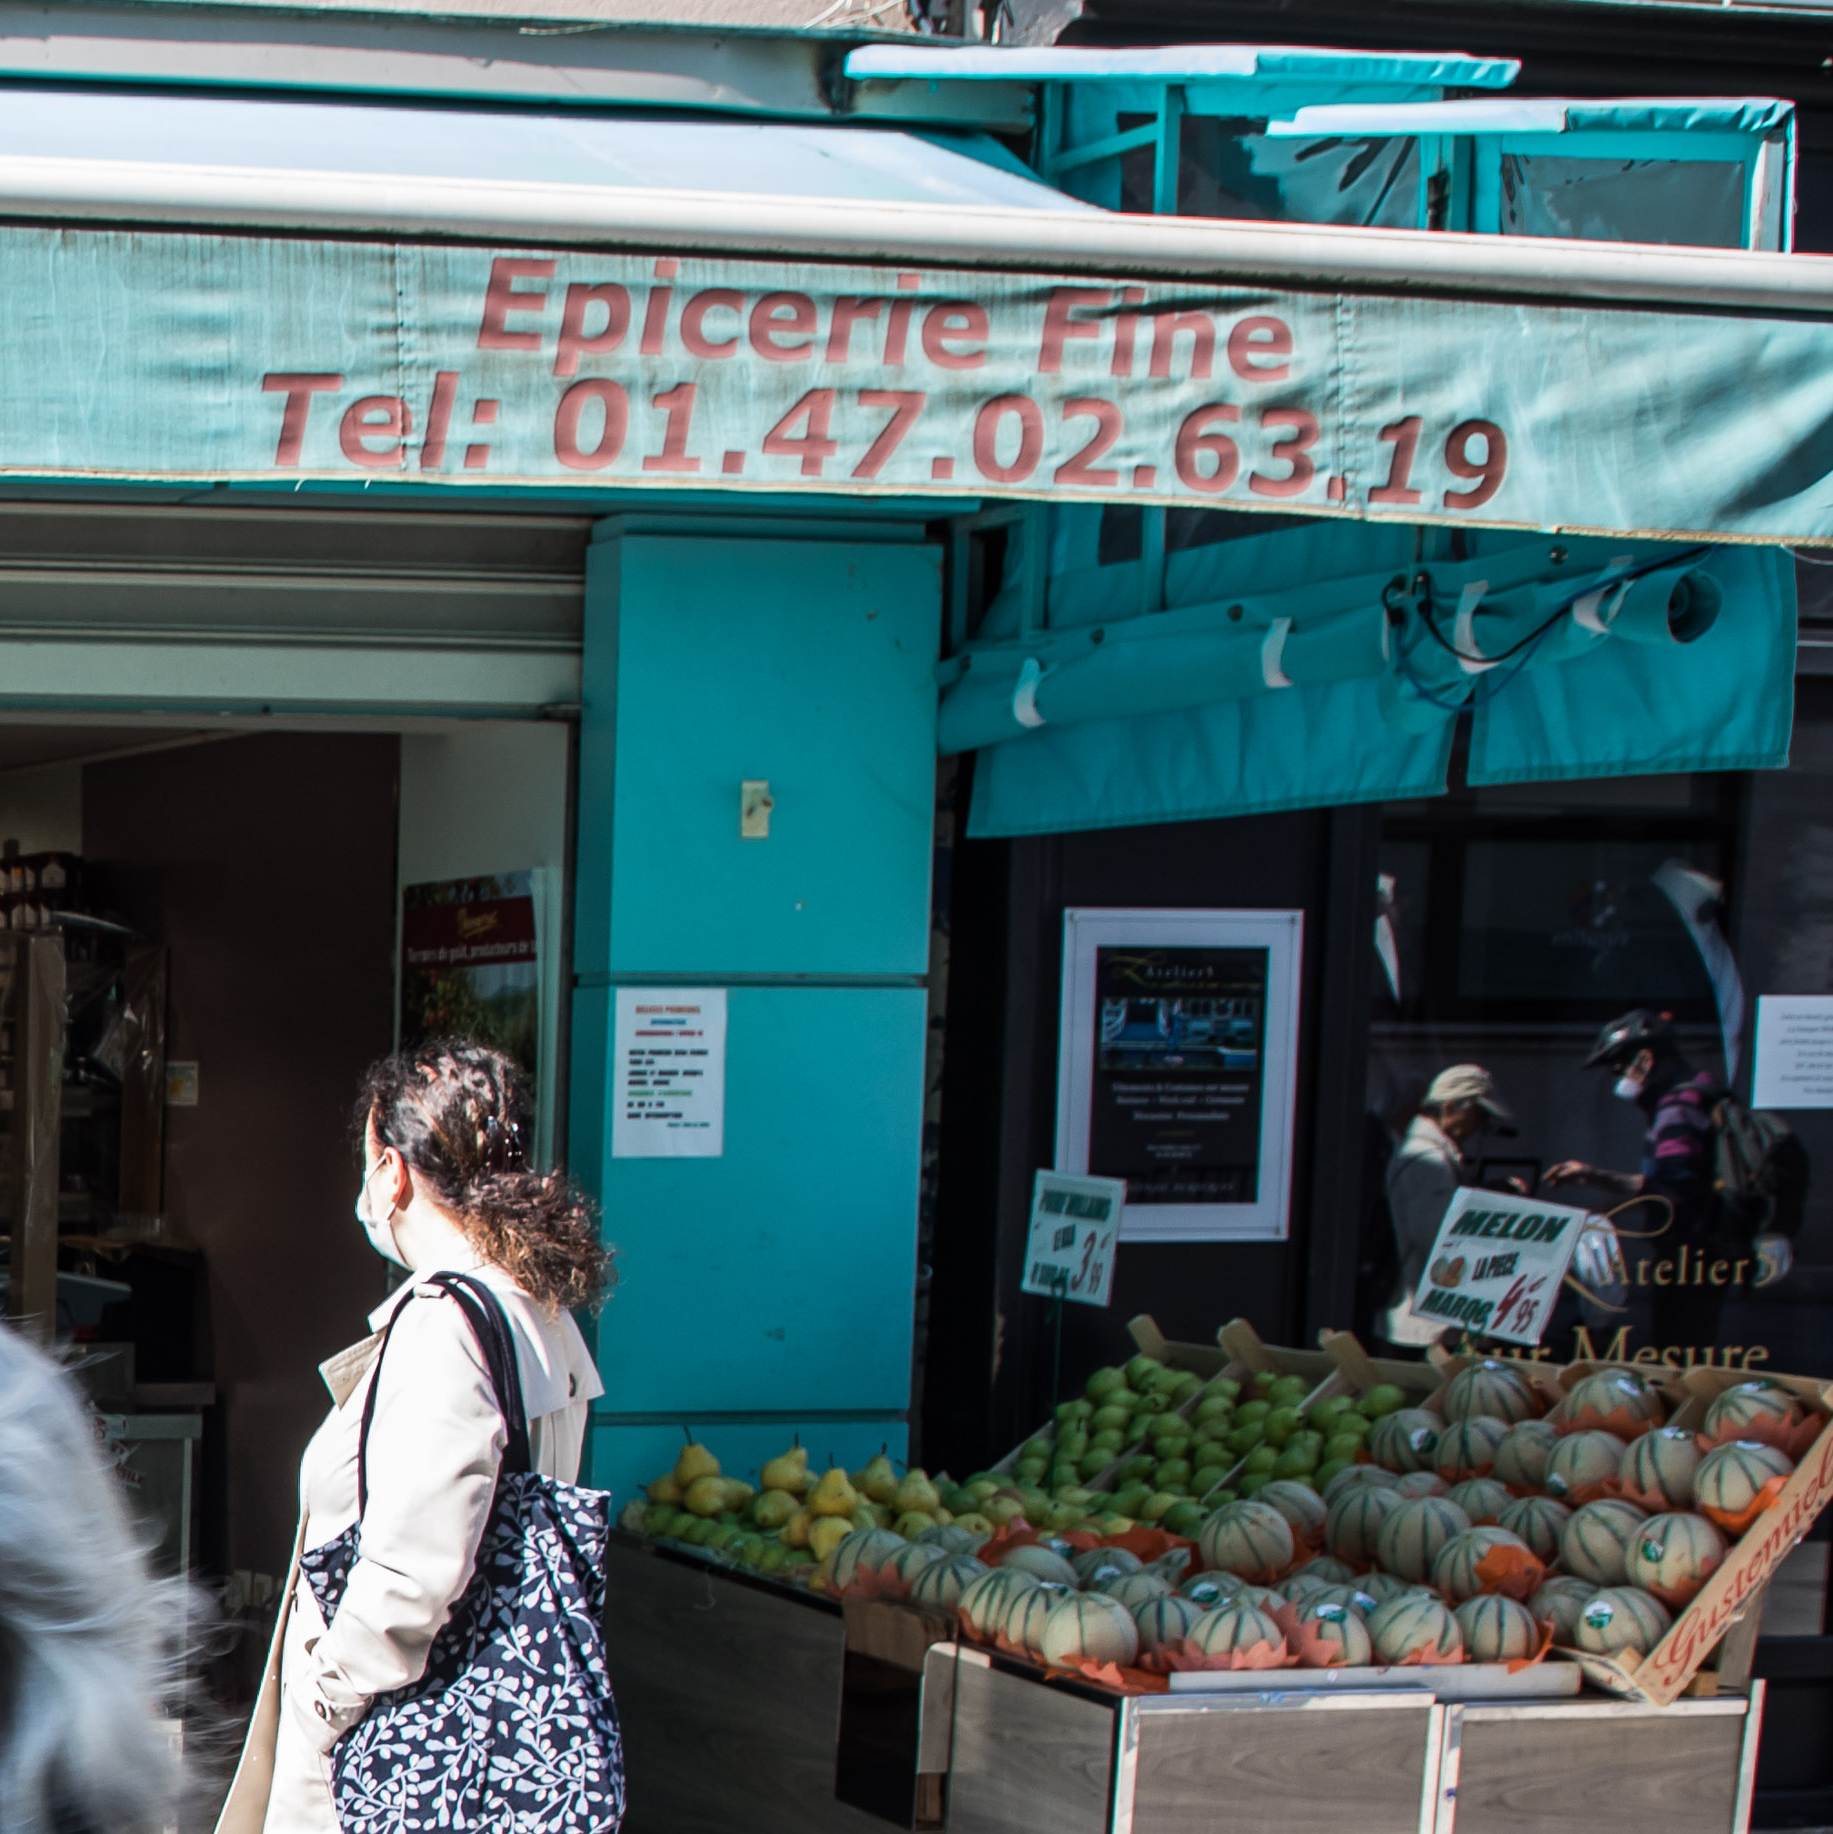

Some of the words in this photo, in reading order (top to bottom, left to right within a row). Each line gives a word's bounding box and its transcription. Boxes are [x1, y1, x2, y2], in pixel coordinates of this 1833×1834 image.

[475, 256, 991, 377] Epicerie
[1036, 284, 1294, 383] Fine
[262, 370, 500, 469] Tel:
[552, 376, 1510, 510] 01.47.02.63.19
[1449, 1208, 1572, 1244] MELON
[1418, 1288, 1496, 1325] MAROC
[1490, 1273, 1529, 1330] 4
[1510, 1297, 1540, 1334] 95
